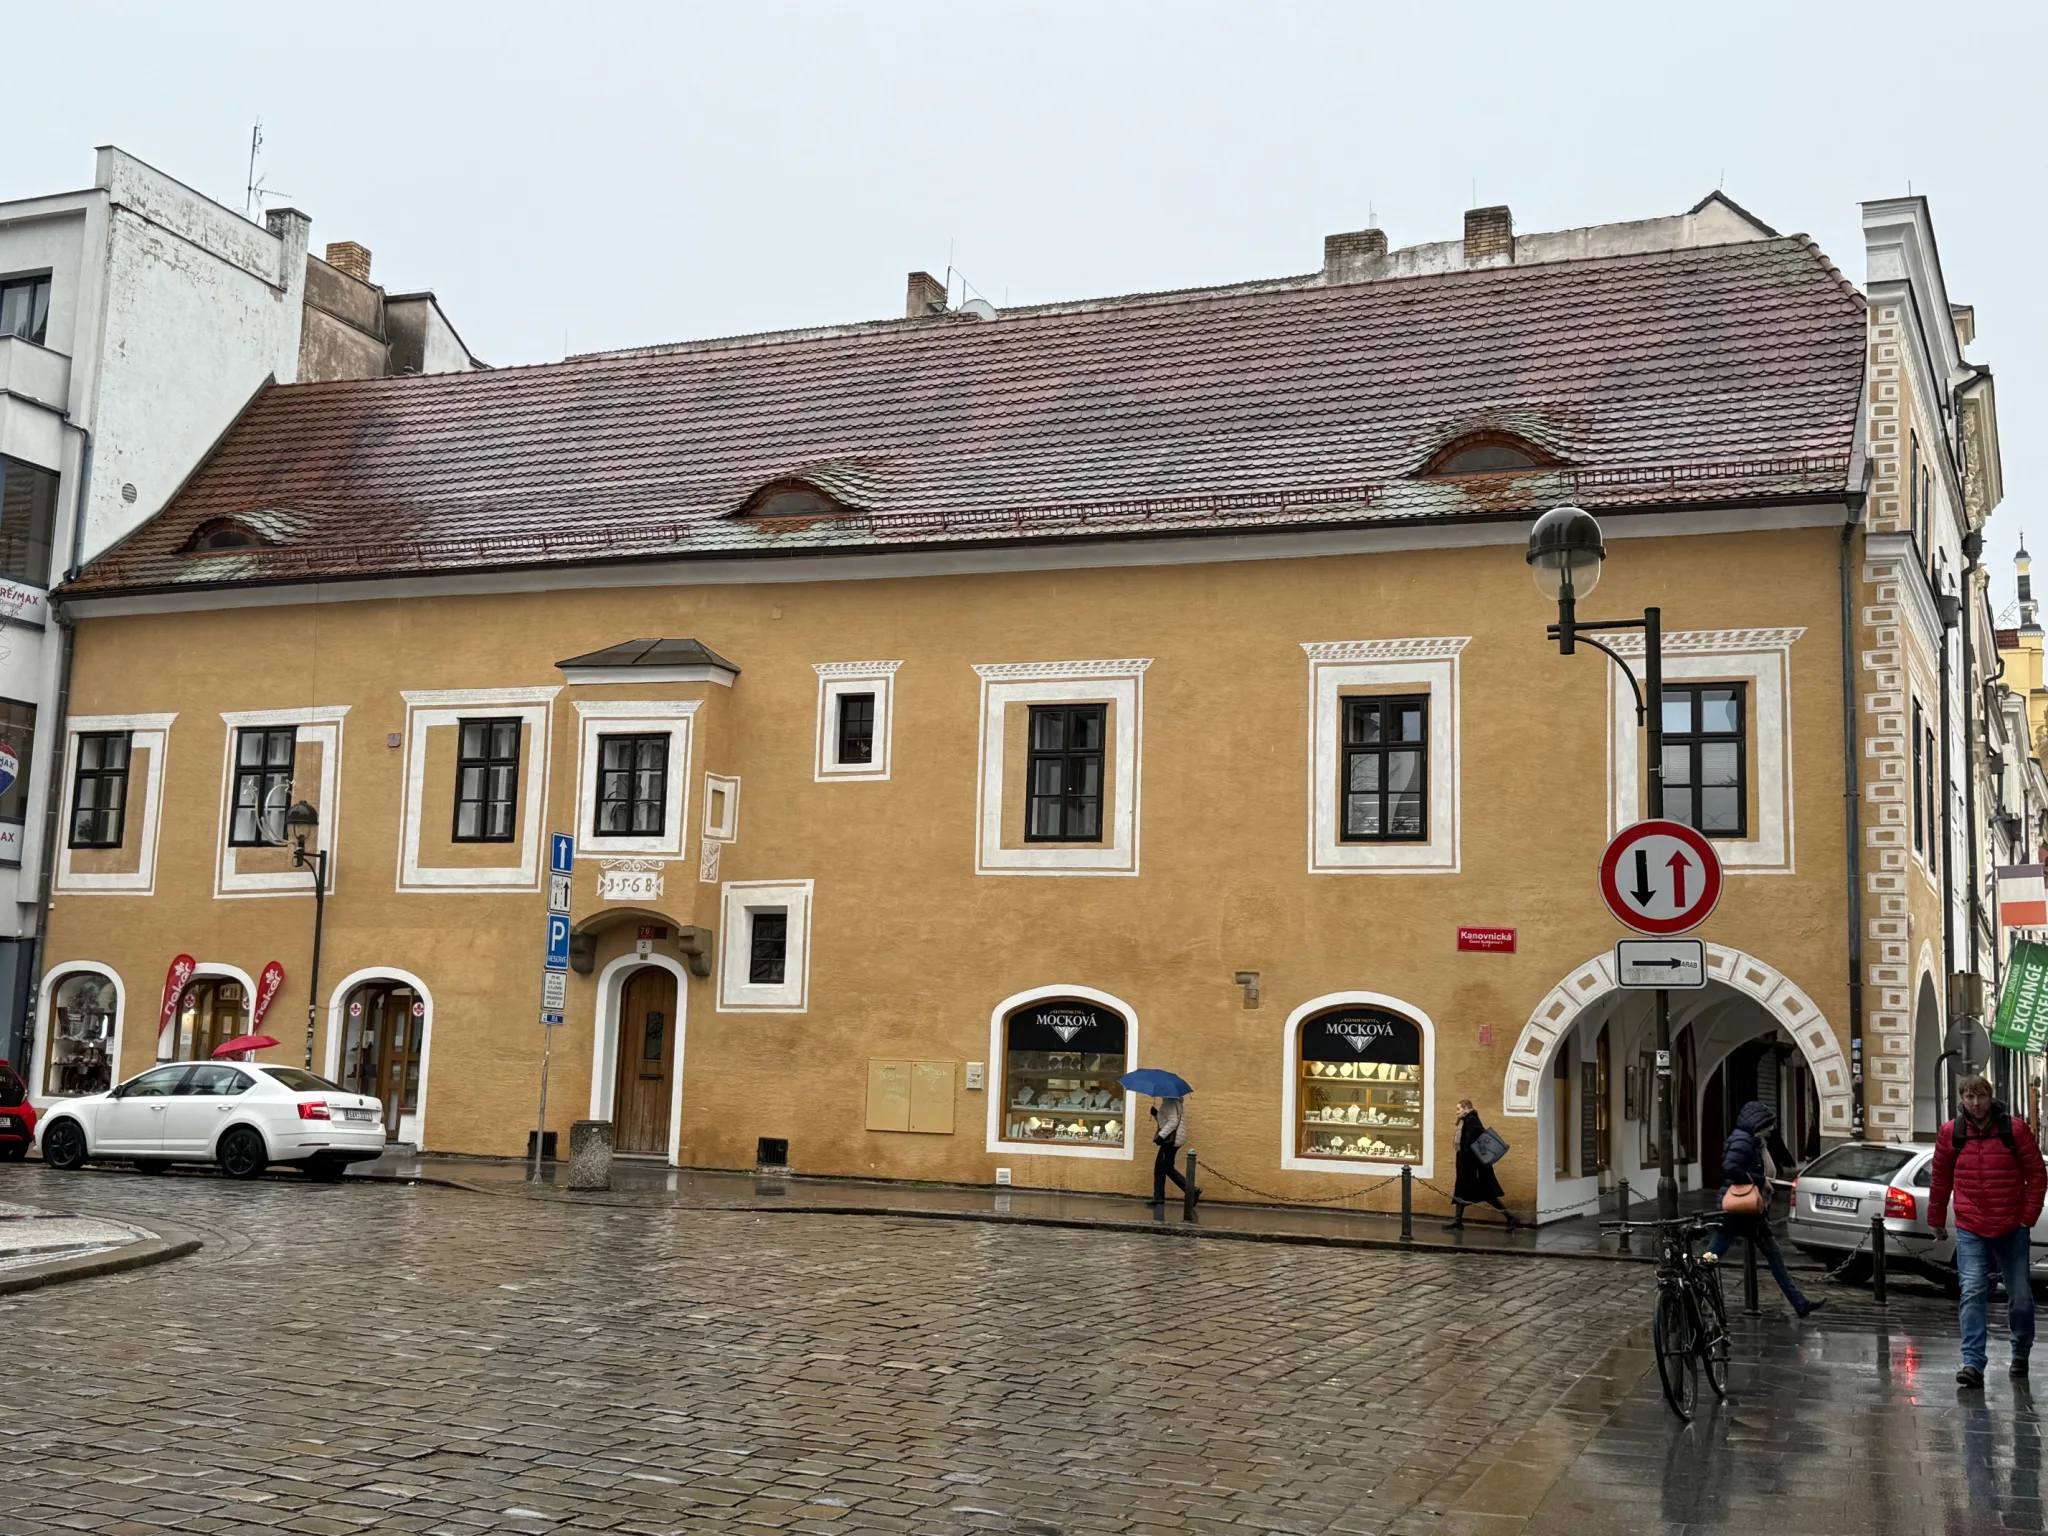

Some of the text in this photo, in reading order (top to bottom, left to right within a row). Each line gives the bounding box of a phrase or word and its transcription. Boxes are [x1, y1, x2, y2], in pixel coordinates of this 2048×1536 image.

[0, 587, 39, 606] RE/MAX
[551, 920, 565, 951] P
[640, 927, 651, 935] 76
[1460, 931, 1512, 941] Kanovnická
[641, 941, 647, 949] 2
[2010, 962, 2044, 1034] EXCHANGE
[1036, 1013, 1098, 1027] MOCKOVÁ
[1325, 1022, 1394, 1035] MOCKOVÁ
